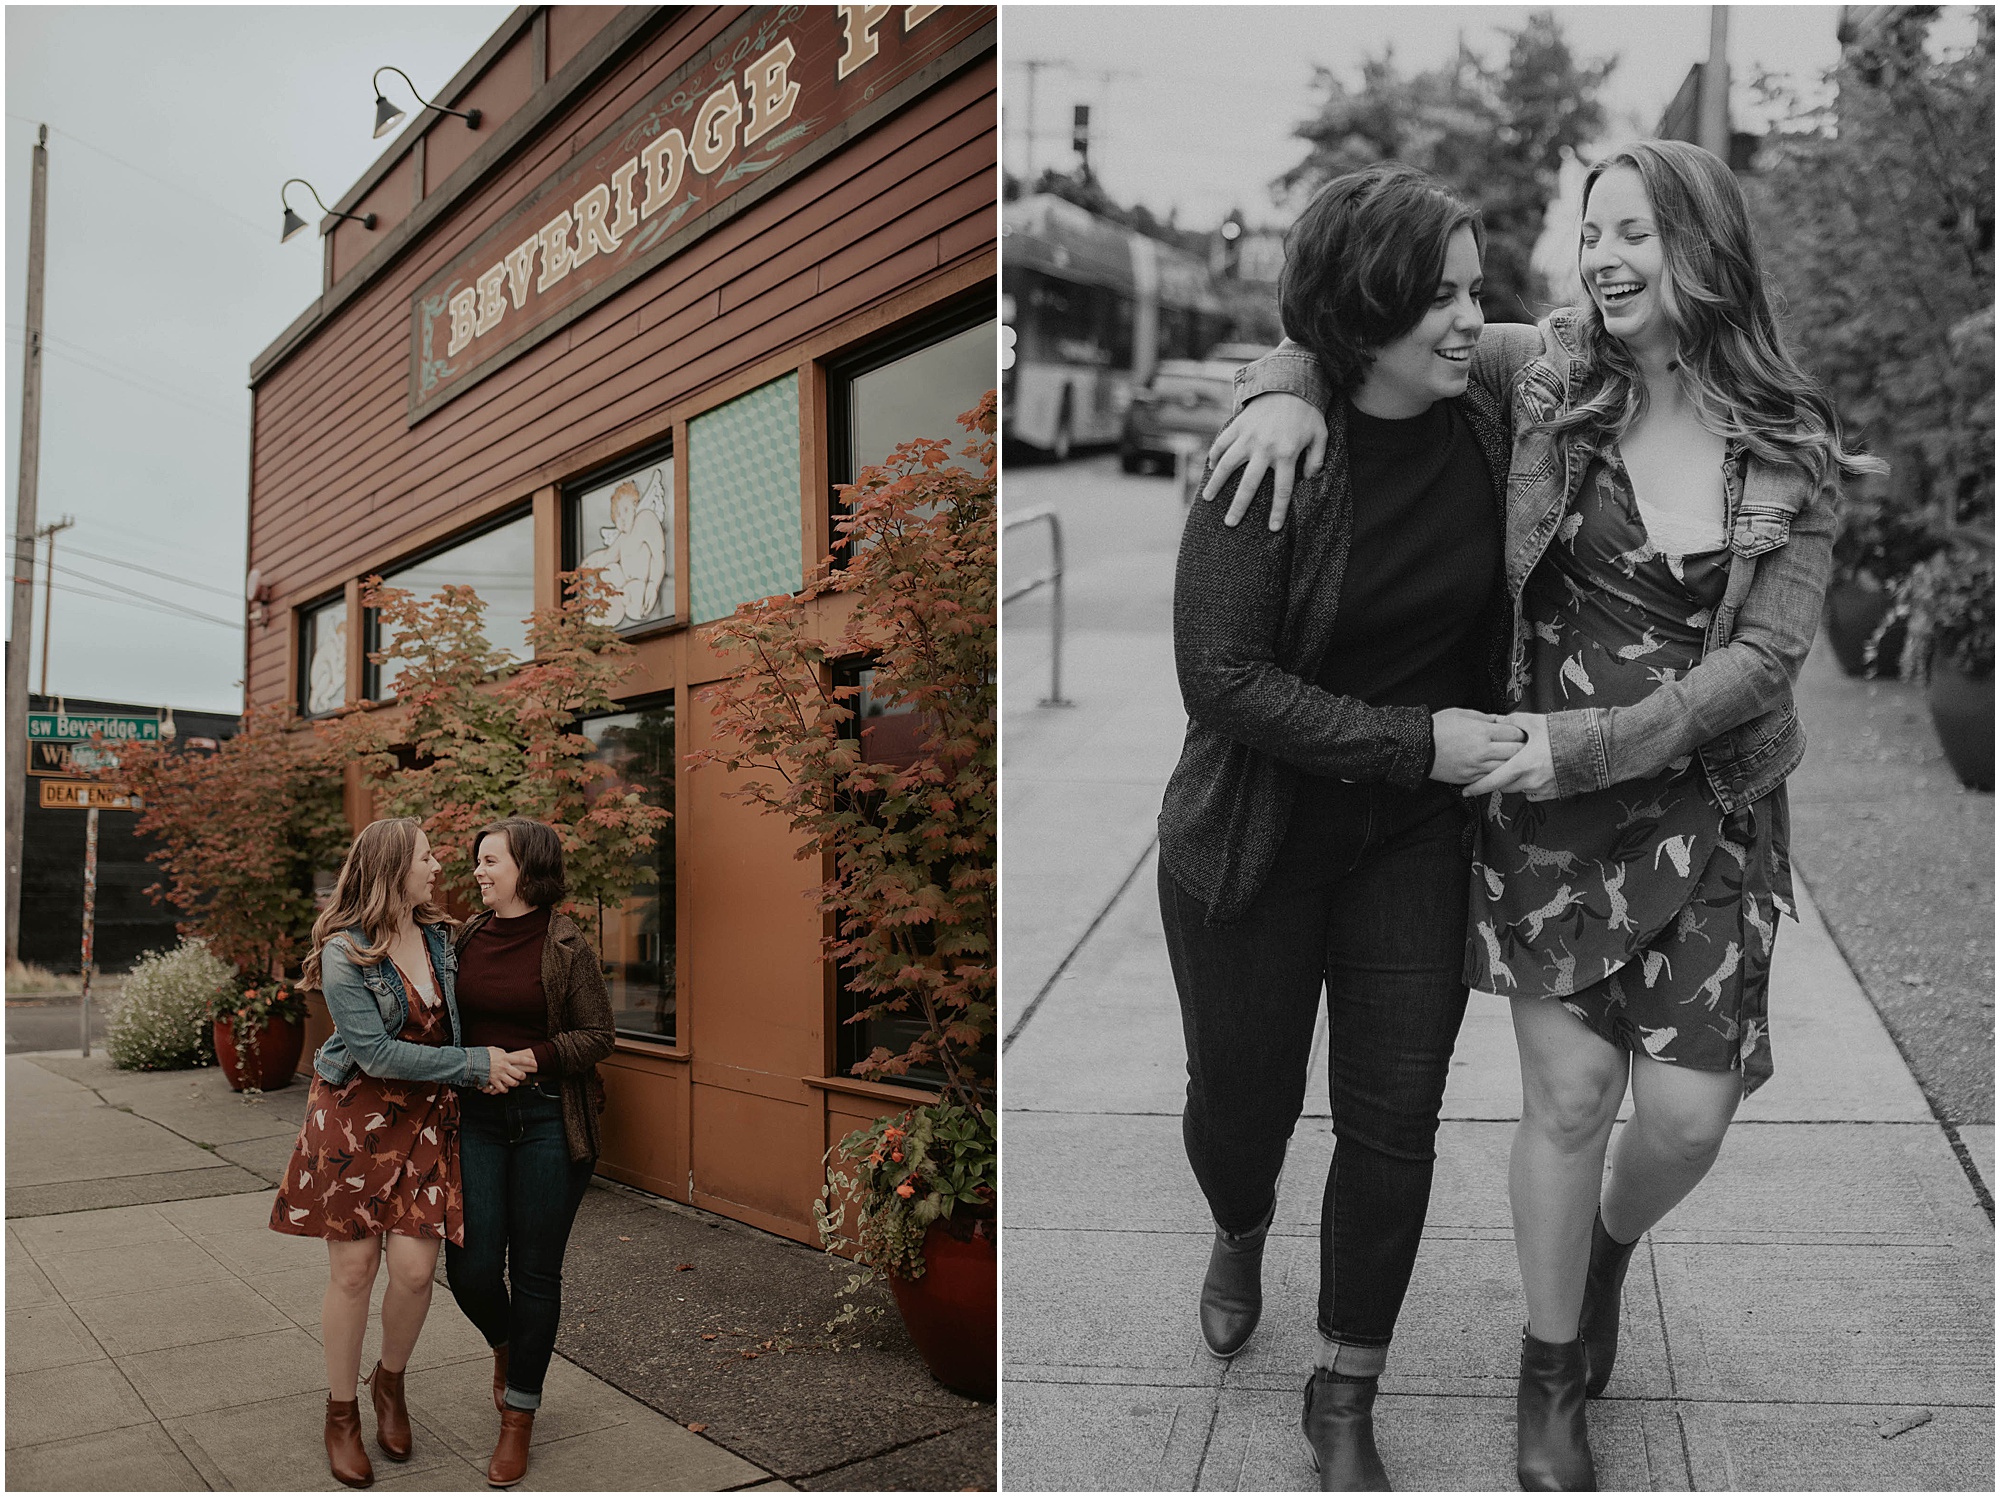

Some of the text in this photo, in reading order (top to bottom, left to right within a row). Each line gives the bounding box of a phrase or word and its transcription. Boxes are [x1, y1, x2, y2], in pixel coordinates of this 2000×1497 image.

[448, 5, 943, 358] BEVERIDGE P
[30, 719, 51, 736] SW
[57, 716, 137, 740] Beveridge
